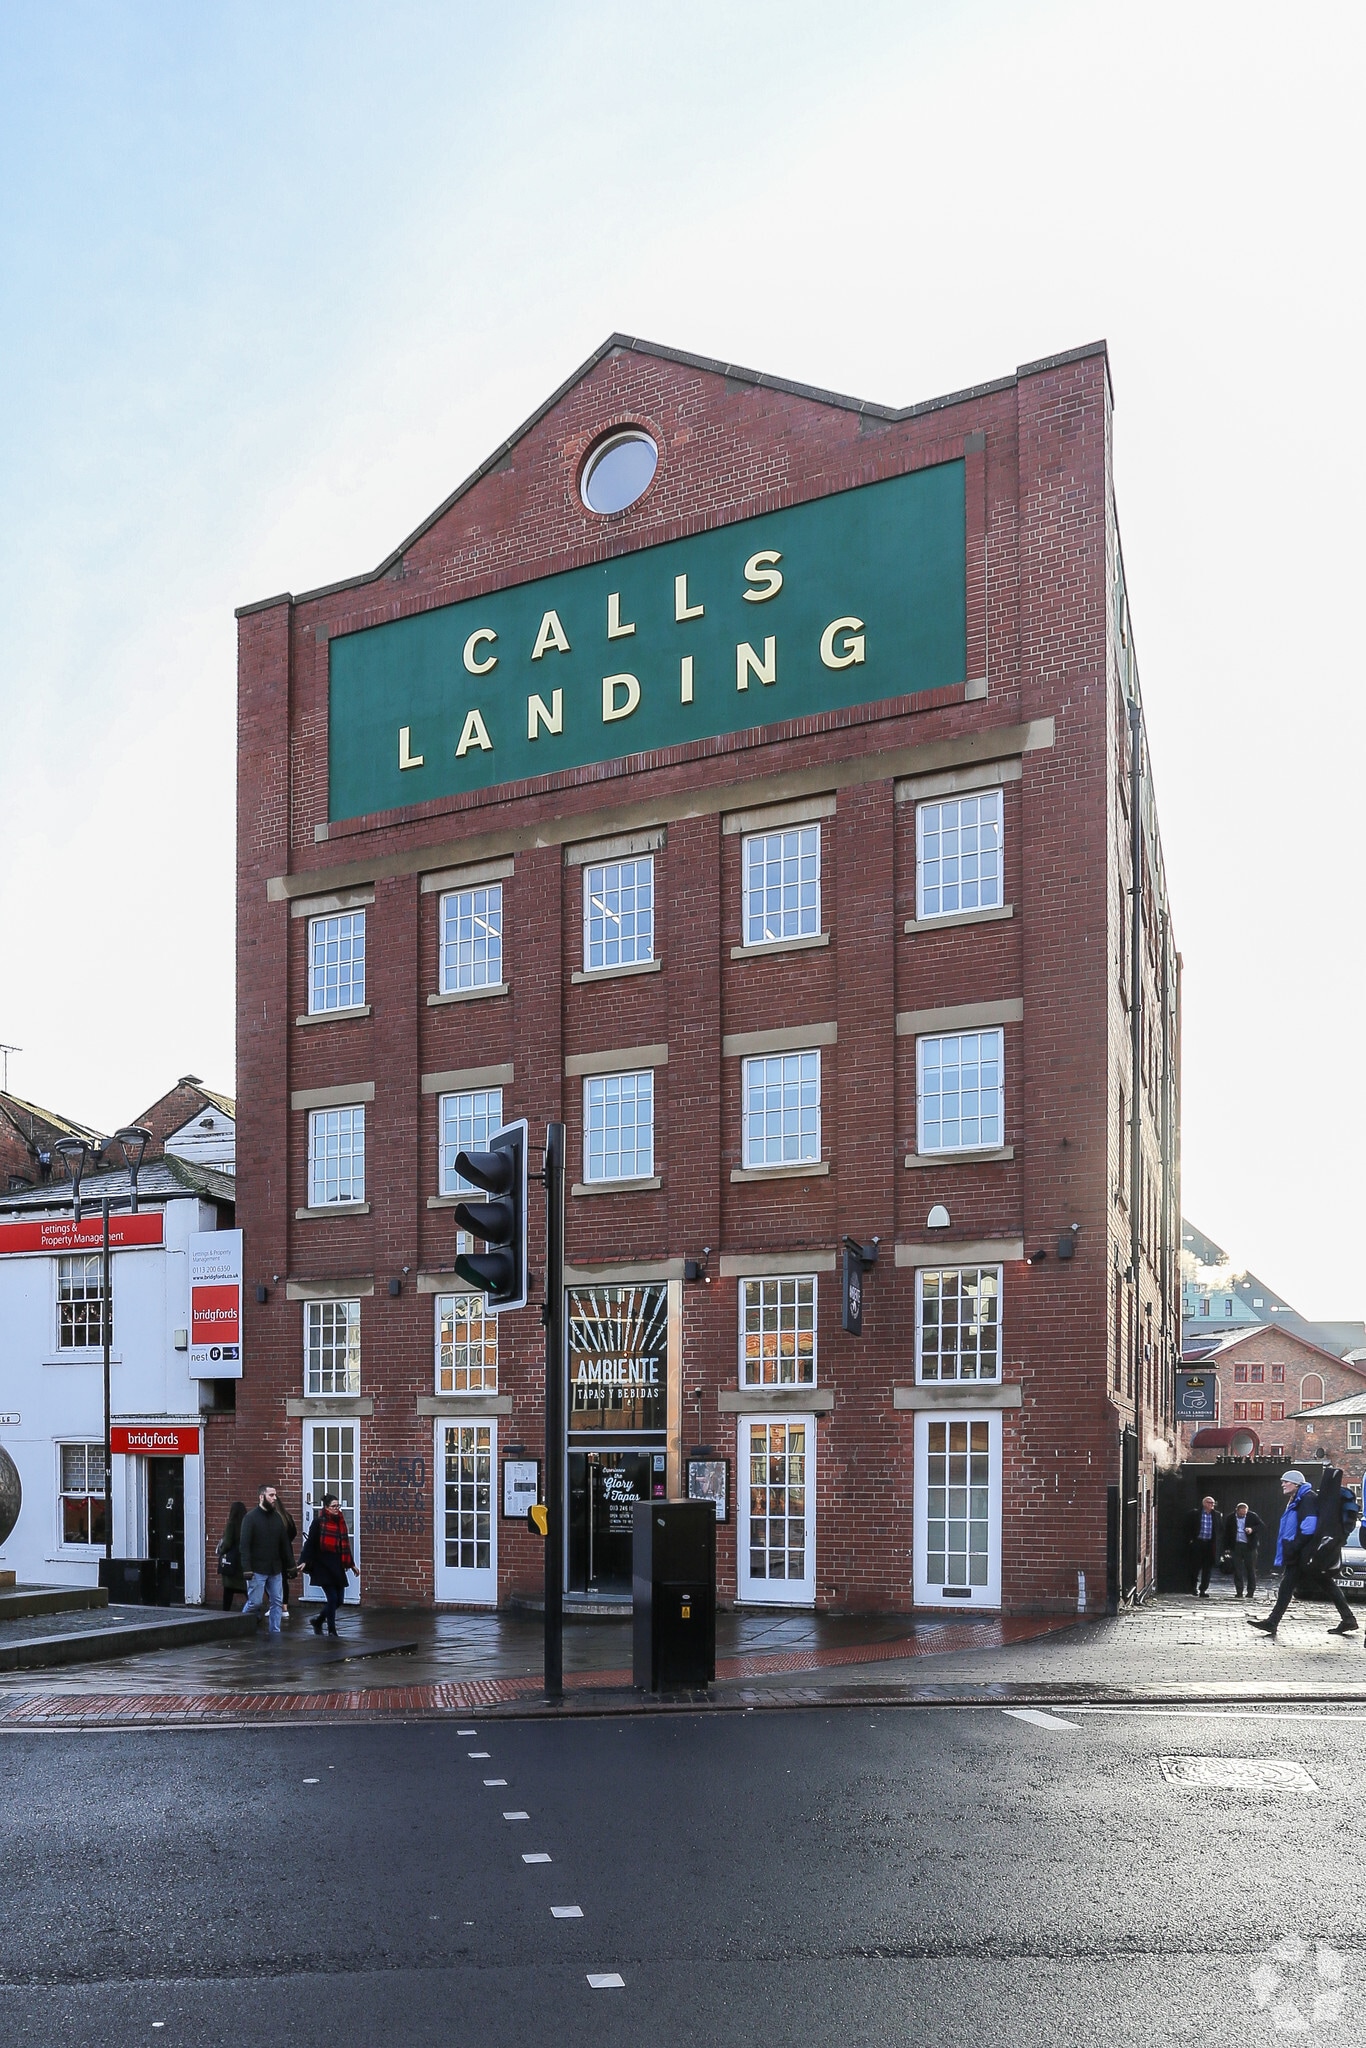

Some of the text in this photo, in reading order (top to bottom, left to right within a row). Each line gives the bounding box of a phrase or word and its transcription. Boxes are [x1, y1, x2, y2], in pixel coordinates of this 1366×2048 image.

[462, 549, 784, 676] CALLS
[397, 616, 867, 771] LANDING
[41, 1222, 78, 1235] Lettings &
[41, 1232, 124, 1246] Property Manageent
[192, 1266, 206, 1274] 0113
[206, 1265, 216, 1273] 200
[193, 1308, 238, 1322] bridgfords
[191, 1353, 208, 1361] nest
[577, 1357, 659, 1385] AMBIENTE
[577, 1388, 659, 1399] TAPAS Y BEBIDAS
[127, 1432, 179, 1448] bridgfords
[398, 1457, 425, 1487] 50
[603, 1477, 634, 1492] Glory
[366, 1492, 425, 1511] WINES &
[603, 1490, 640, 1503] of Tapas
[365, 1514, 425, 1532] SHERRIES
